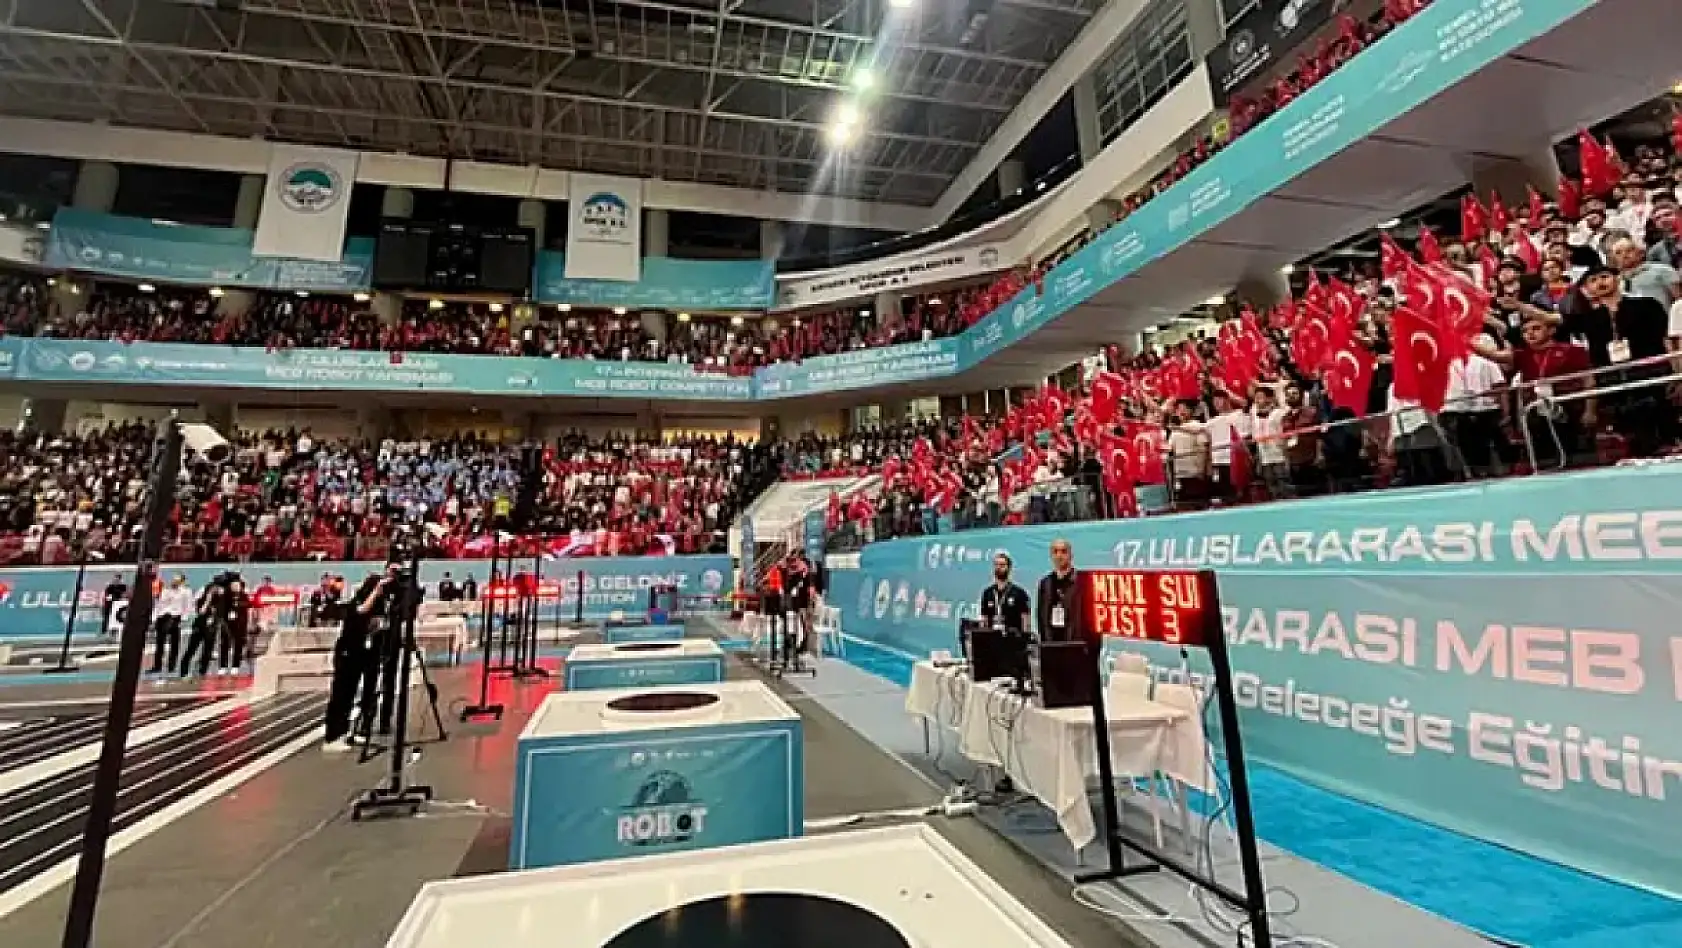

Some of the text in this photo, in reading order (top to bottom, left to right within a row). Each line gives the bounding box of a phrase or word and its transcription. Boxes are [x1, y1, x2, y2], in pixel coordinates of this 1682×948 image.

[1092, 573, 1147, 605] MINI
[1094, 604, 1180, 644] PIST 3
[1434, 619, 1646, 695] MEB
[1231, 670, 1455, 757] Geleceğe
[617, 807, 708, 843] ROBOT
